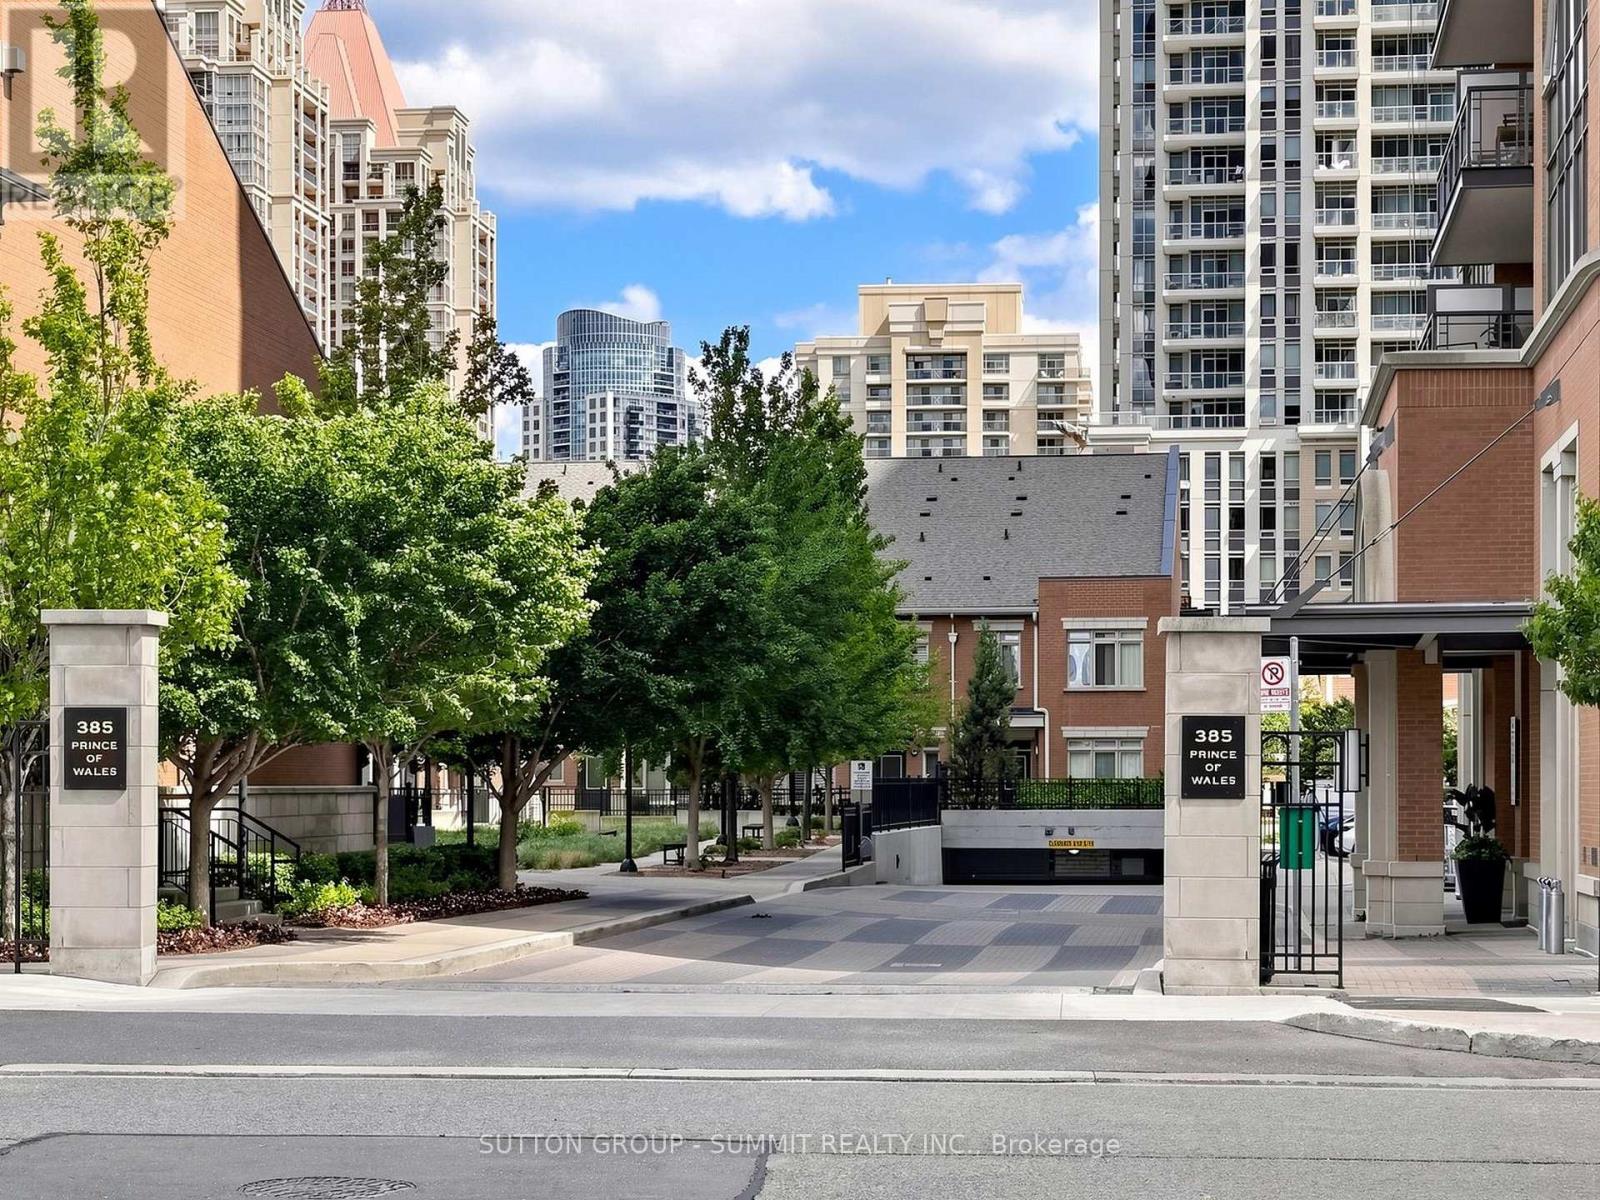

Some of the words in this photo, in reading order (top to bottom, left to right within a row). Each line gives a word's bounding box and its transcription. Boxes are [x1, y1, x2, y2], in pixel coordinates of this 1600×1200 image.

[77, 721, 113, 734] 385
[1195, 730, 1233, 743] 385
[71, 741, 118, 750] PRINCE
[86, 754, 103, 763] OF
[1190, 751, 1237, 759] PRINCE
[73, 767, 117, 776] WALES
[1205, 763, 1222, 772] OF
[1191, 776, 1236, 785] WALES
